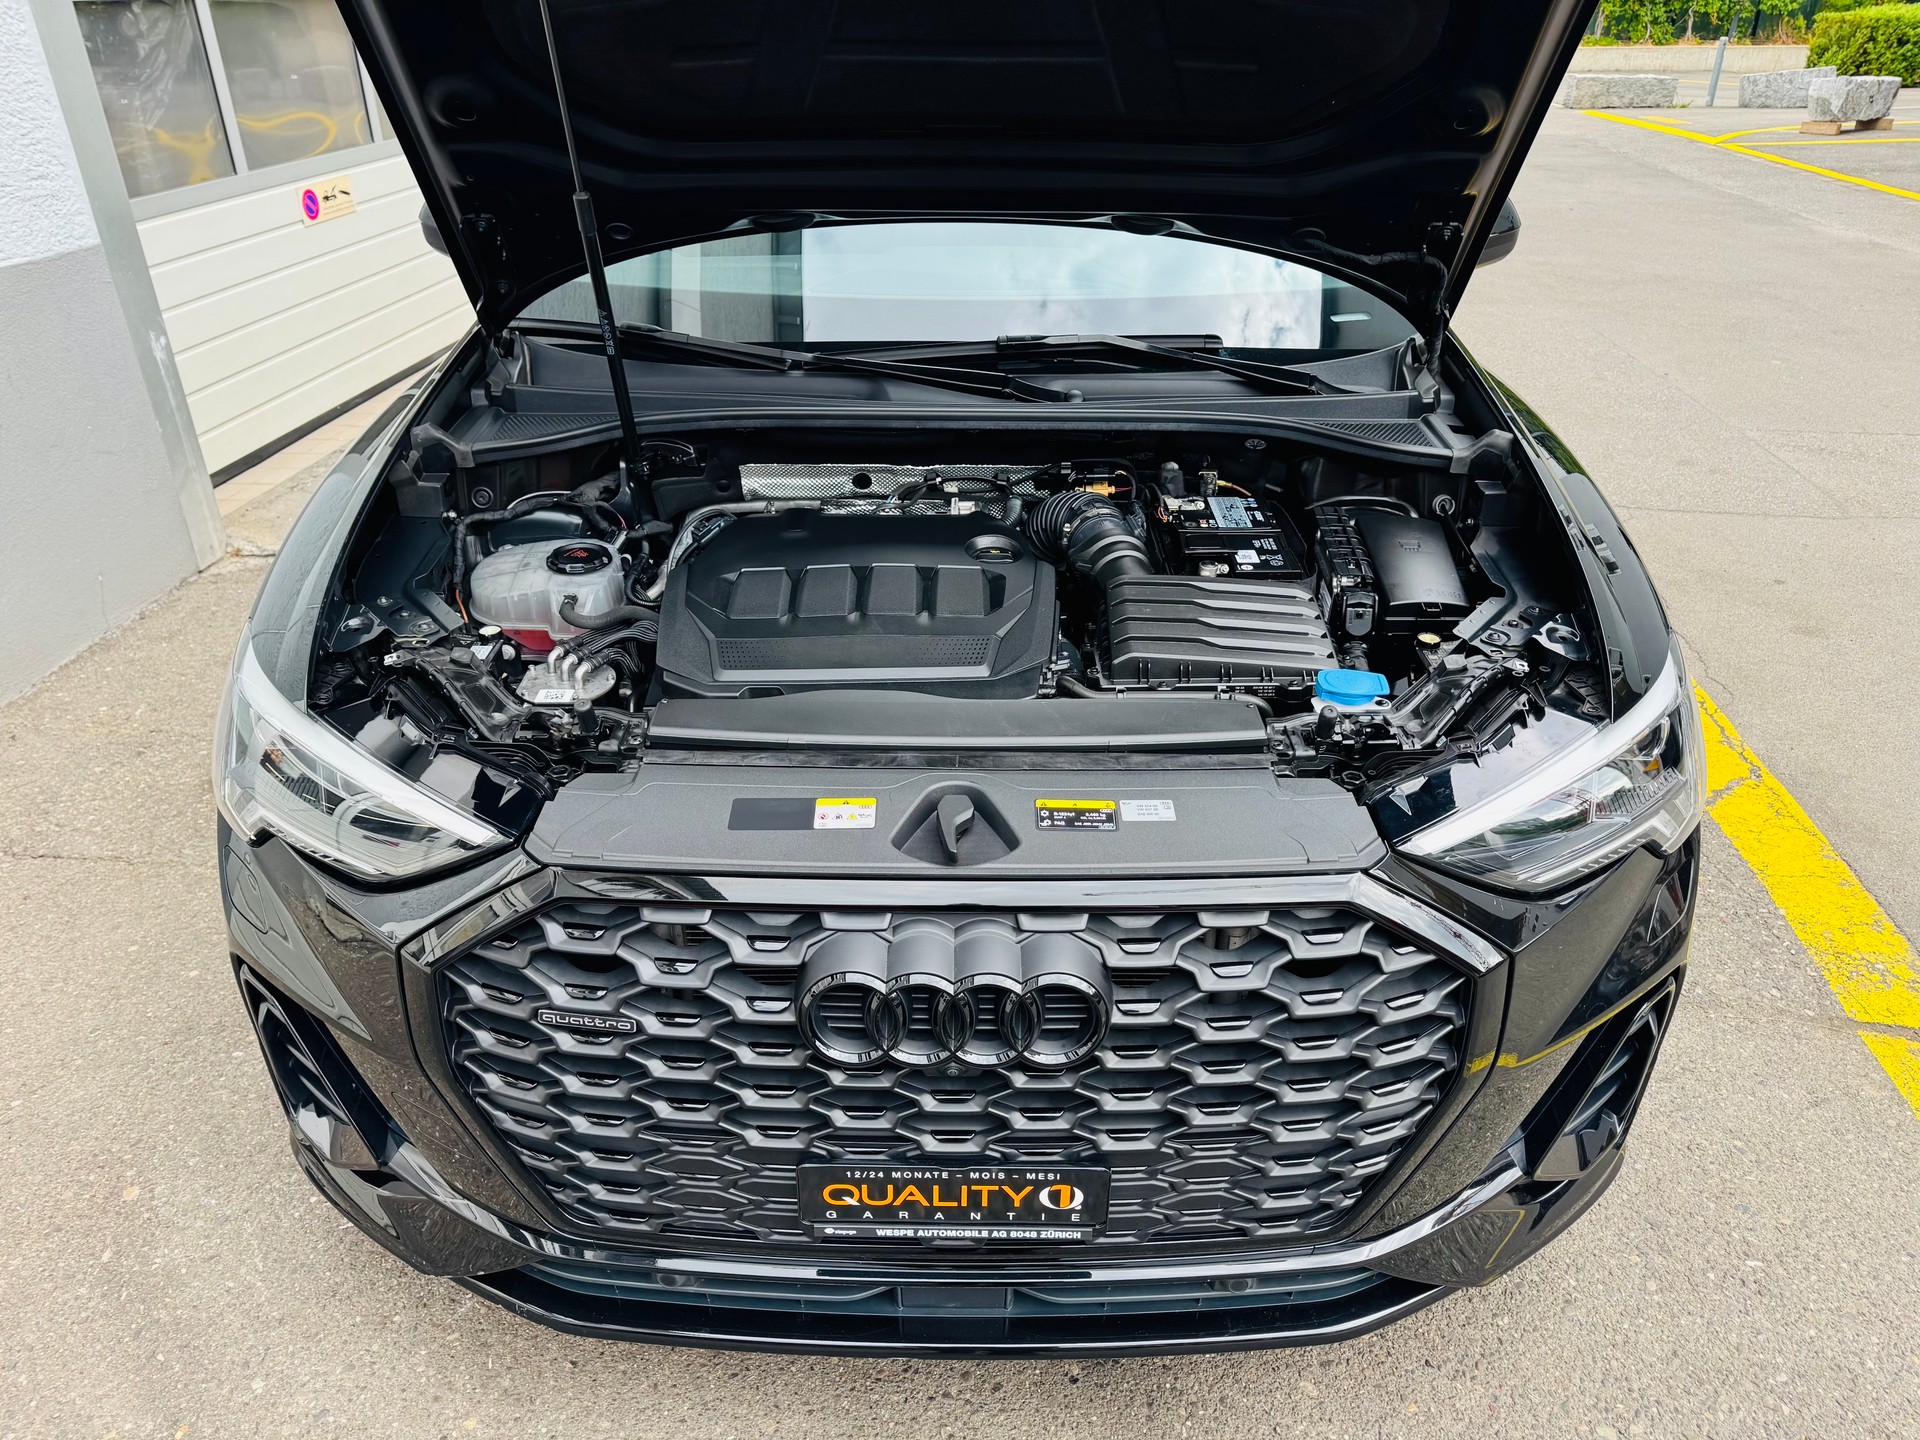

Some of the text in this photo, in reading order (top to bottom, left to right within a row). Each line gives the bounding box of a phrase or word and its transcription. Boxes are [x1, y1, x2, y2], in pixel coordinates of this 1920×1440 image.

[542, 1014, 632, 1030] quattro
[845, 1171, 885, 1179] 12/24
[891, 1171, 950, 1180] MONATE
[969, 1171, 1006, 1180] MOIS
[1026, 1172, 1061, 1181] MESI
[822, 1183, 1035, 1208] QUALITY
[875, 1228, 1082, 1240] WESPE AUTOMOBILE AG 8048 ZÜRICH
